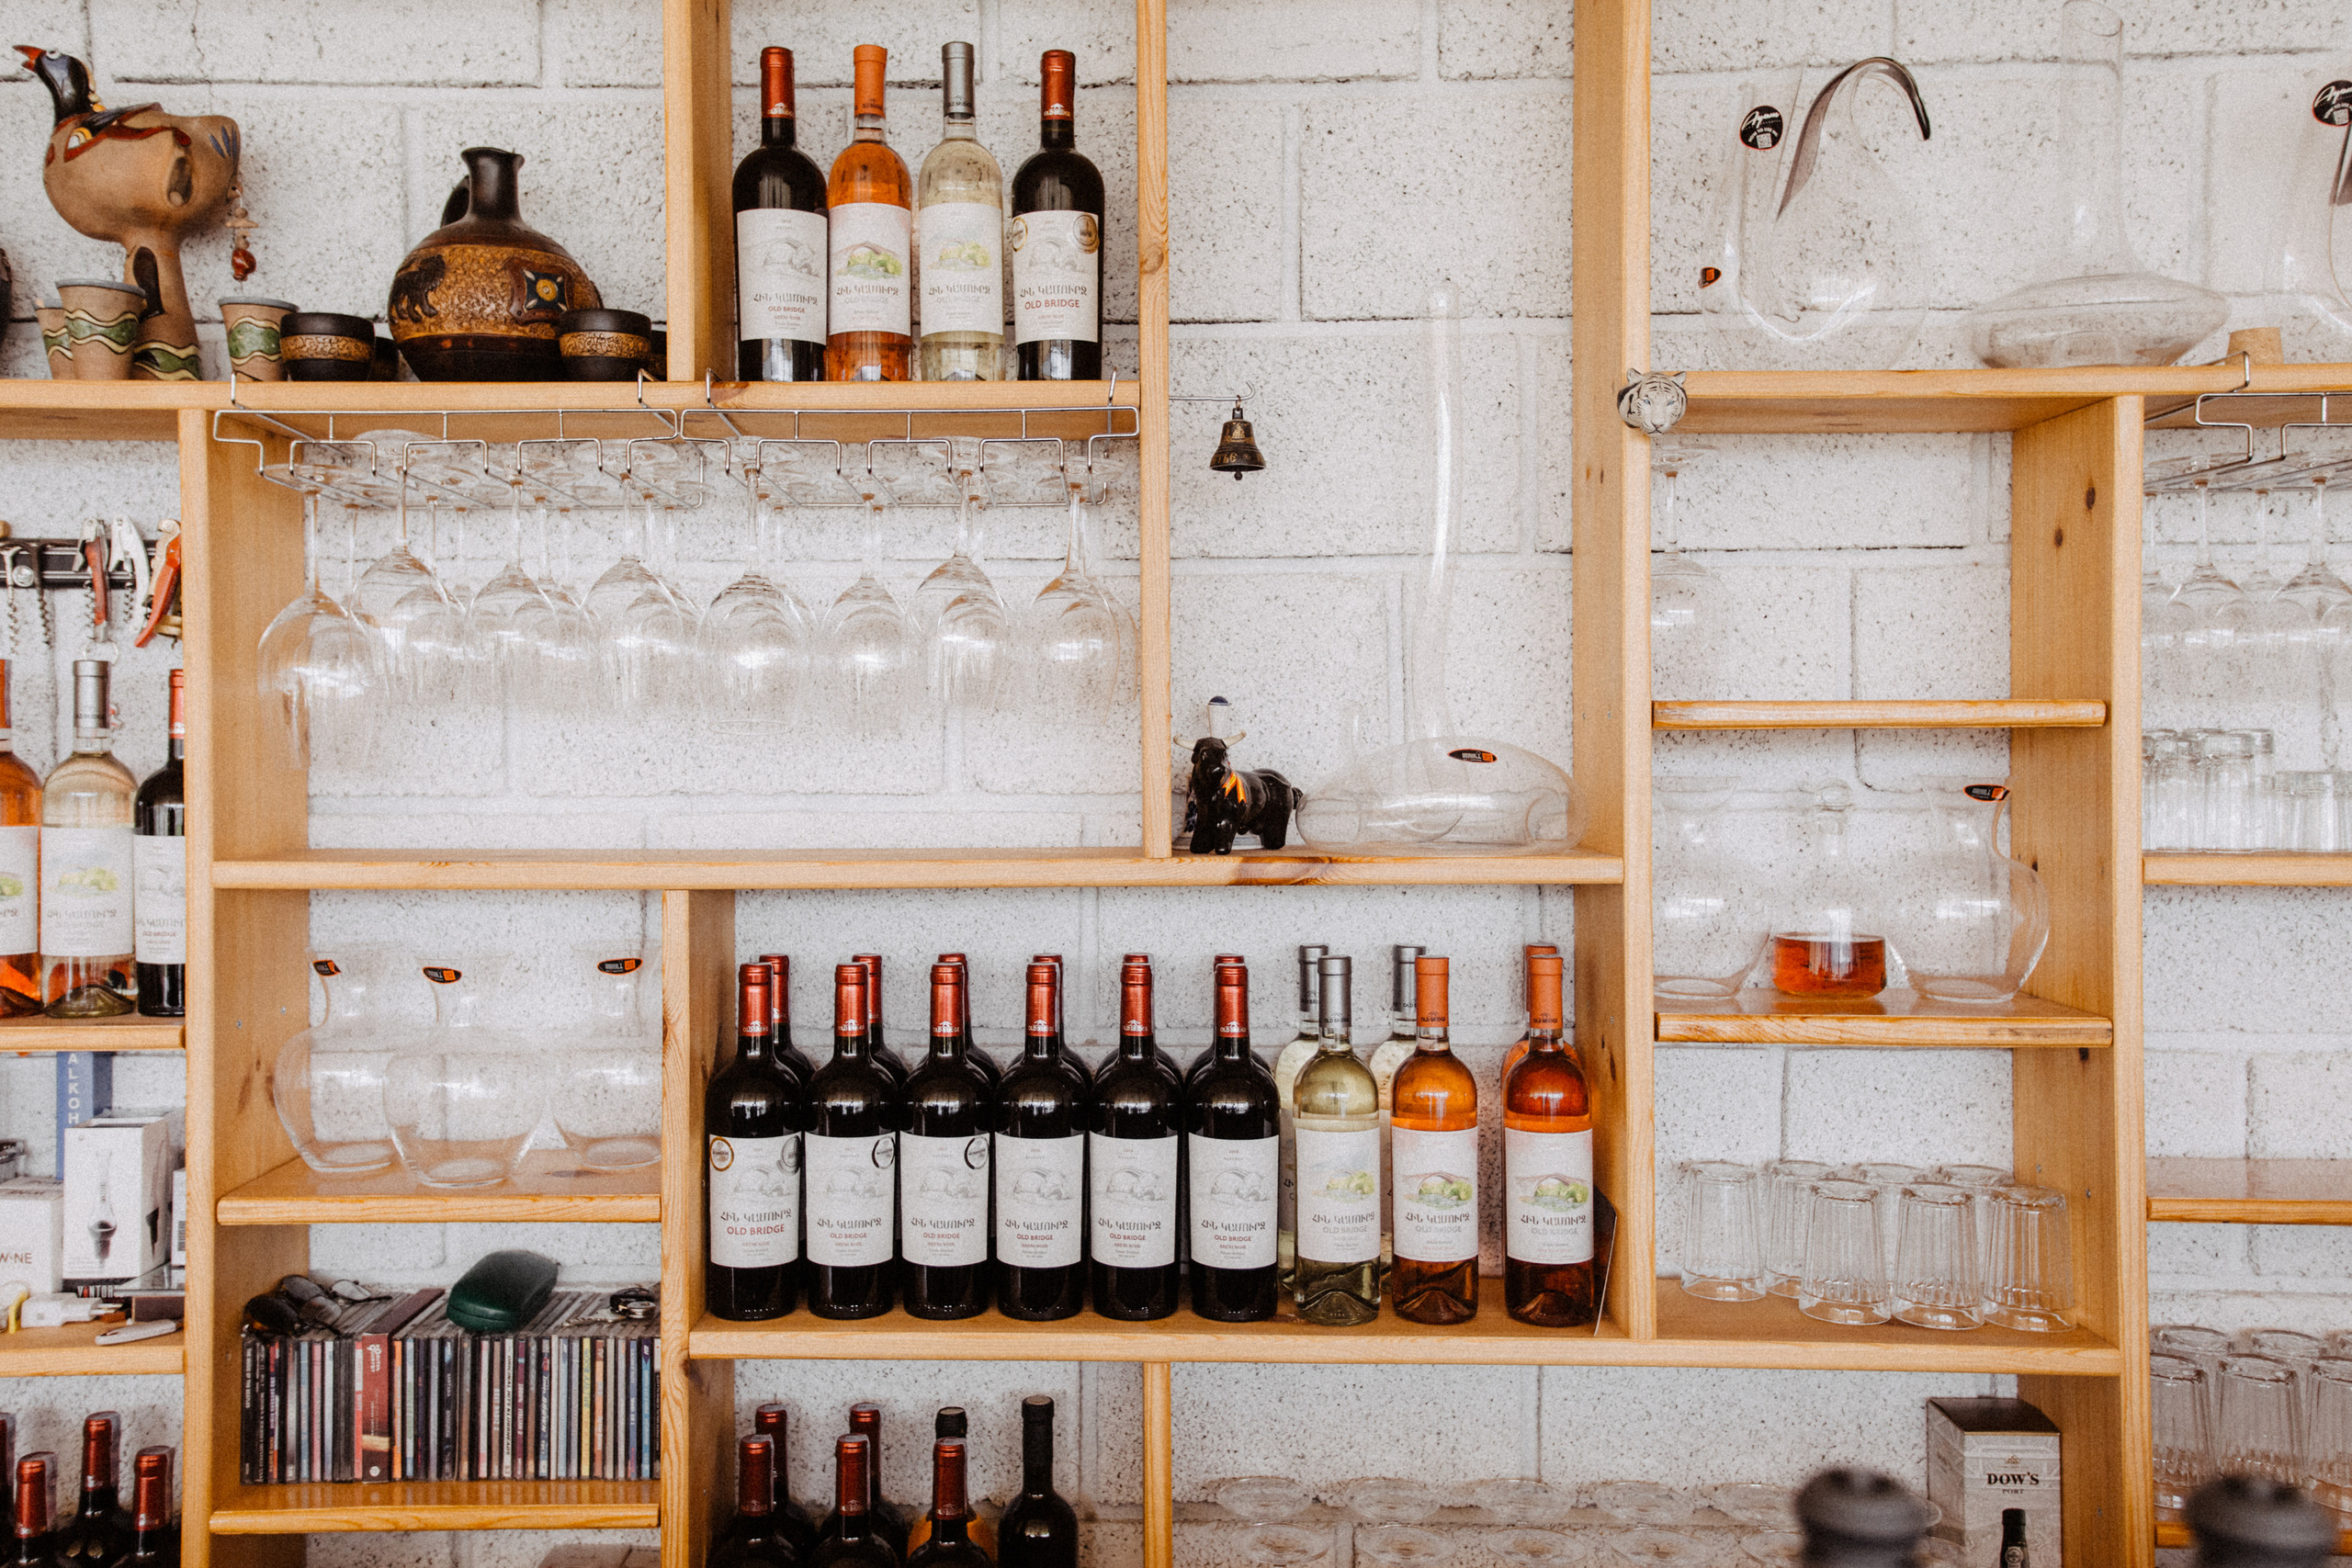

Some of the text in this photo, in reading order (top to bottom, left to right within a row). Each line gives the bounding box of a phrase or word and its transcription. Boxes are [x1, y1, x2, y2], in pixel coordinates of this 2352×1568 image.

[1024, 299, 1080, 310] OLD BRIDGE
[727, 1224, 785, 1235] OLD BRIDGE
[0, 1252, 32, 1264] WNE
[1986, 1472, 2040, 1485] DOW'S
